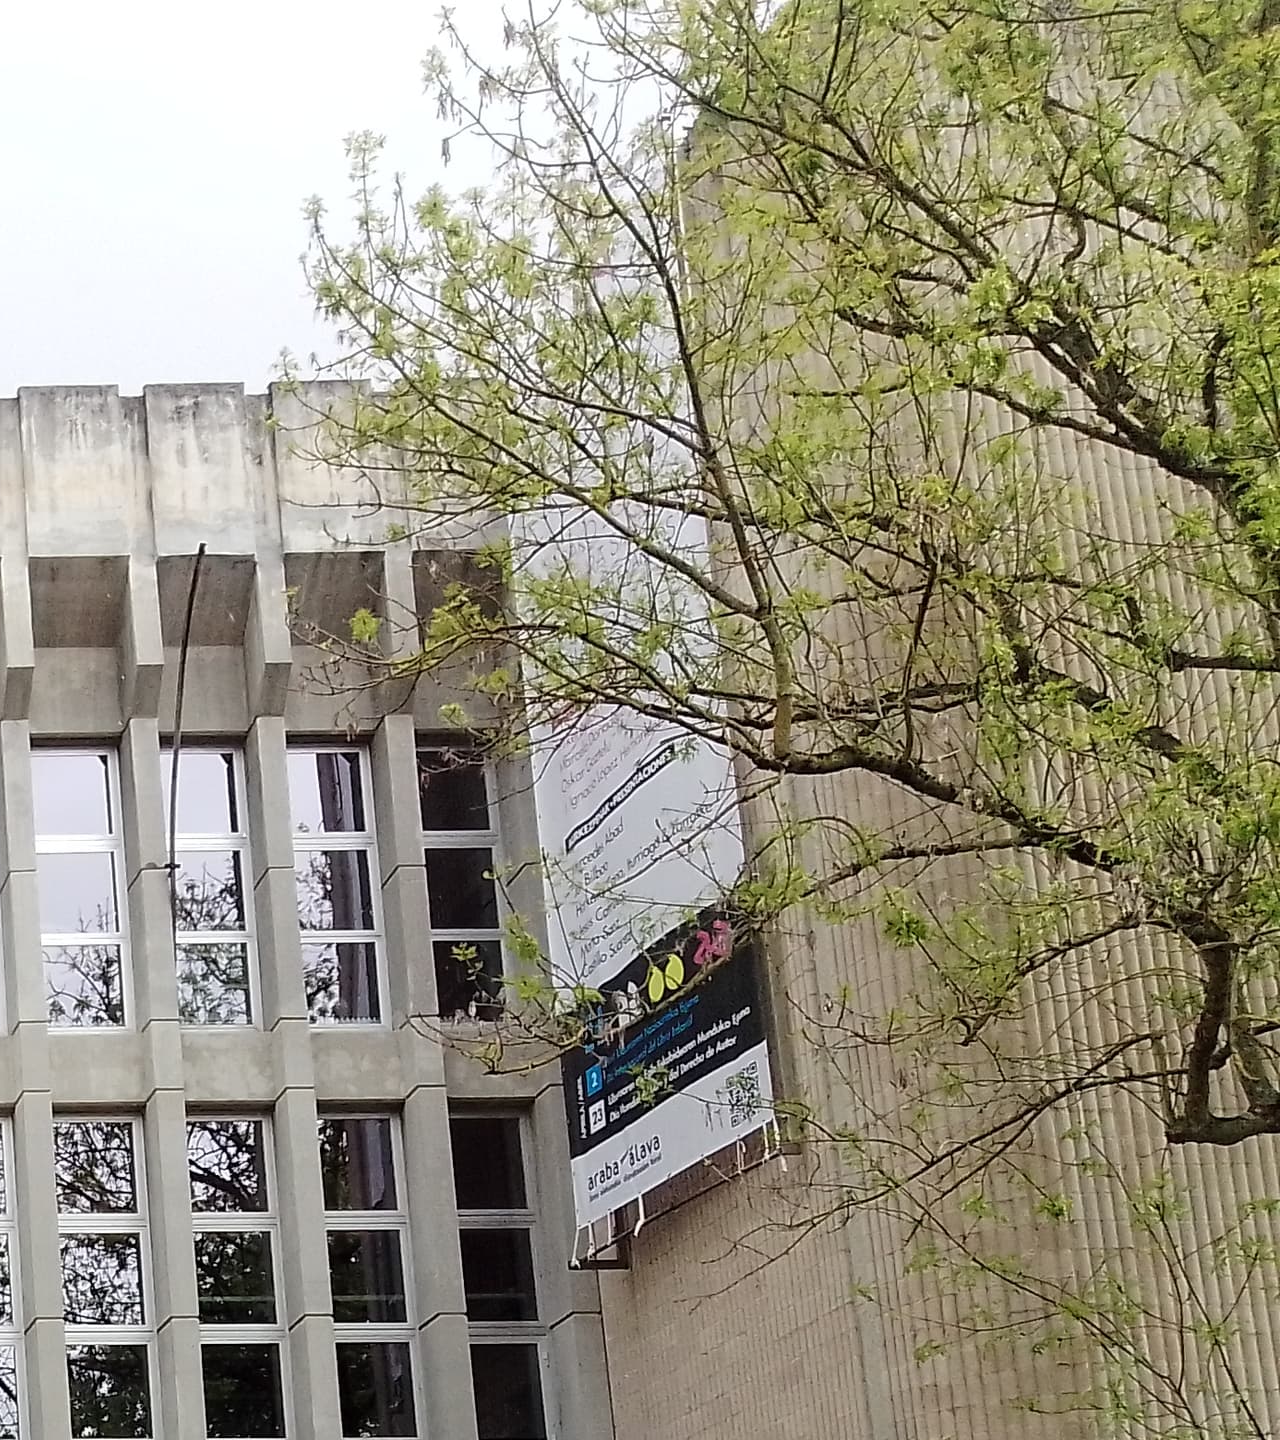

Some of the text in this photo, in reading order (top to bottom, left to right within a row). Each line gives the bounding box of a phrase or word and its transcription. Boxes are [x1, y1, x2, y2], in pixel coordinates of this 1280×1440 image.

[591, 1106, 604, 1127] 23
[587, 1135, 662, 1191] araba álava
